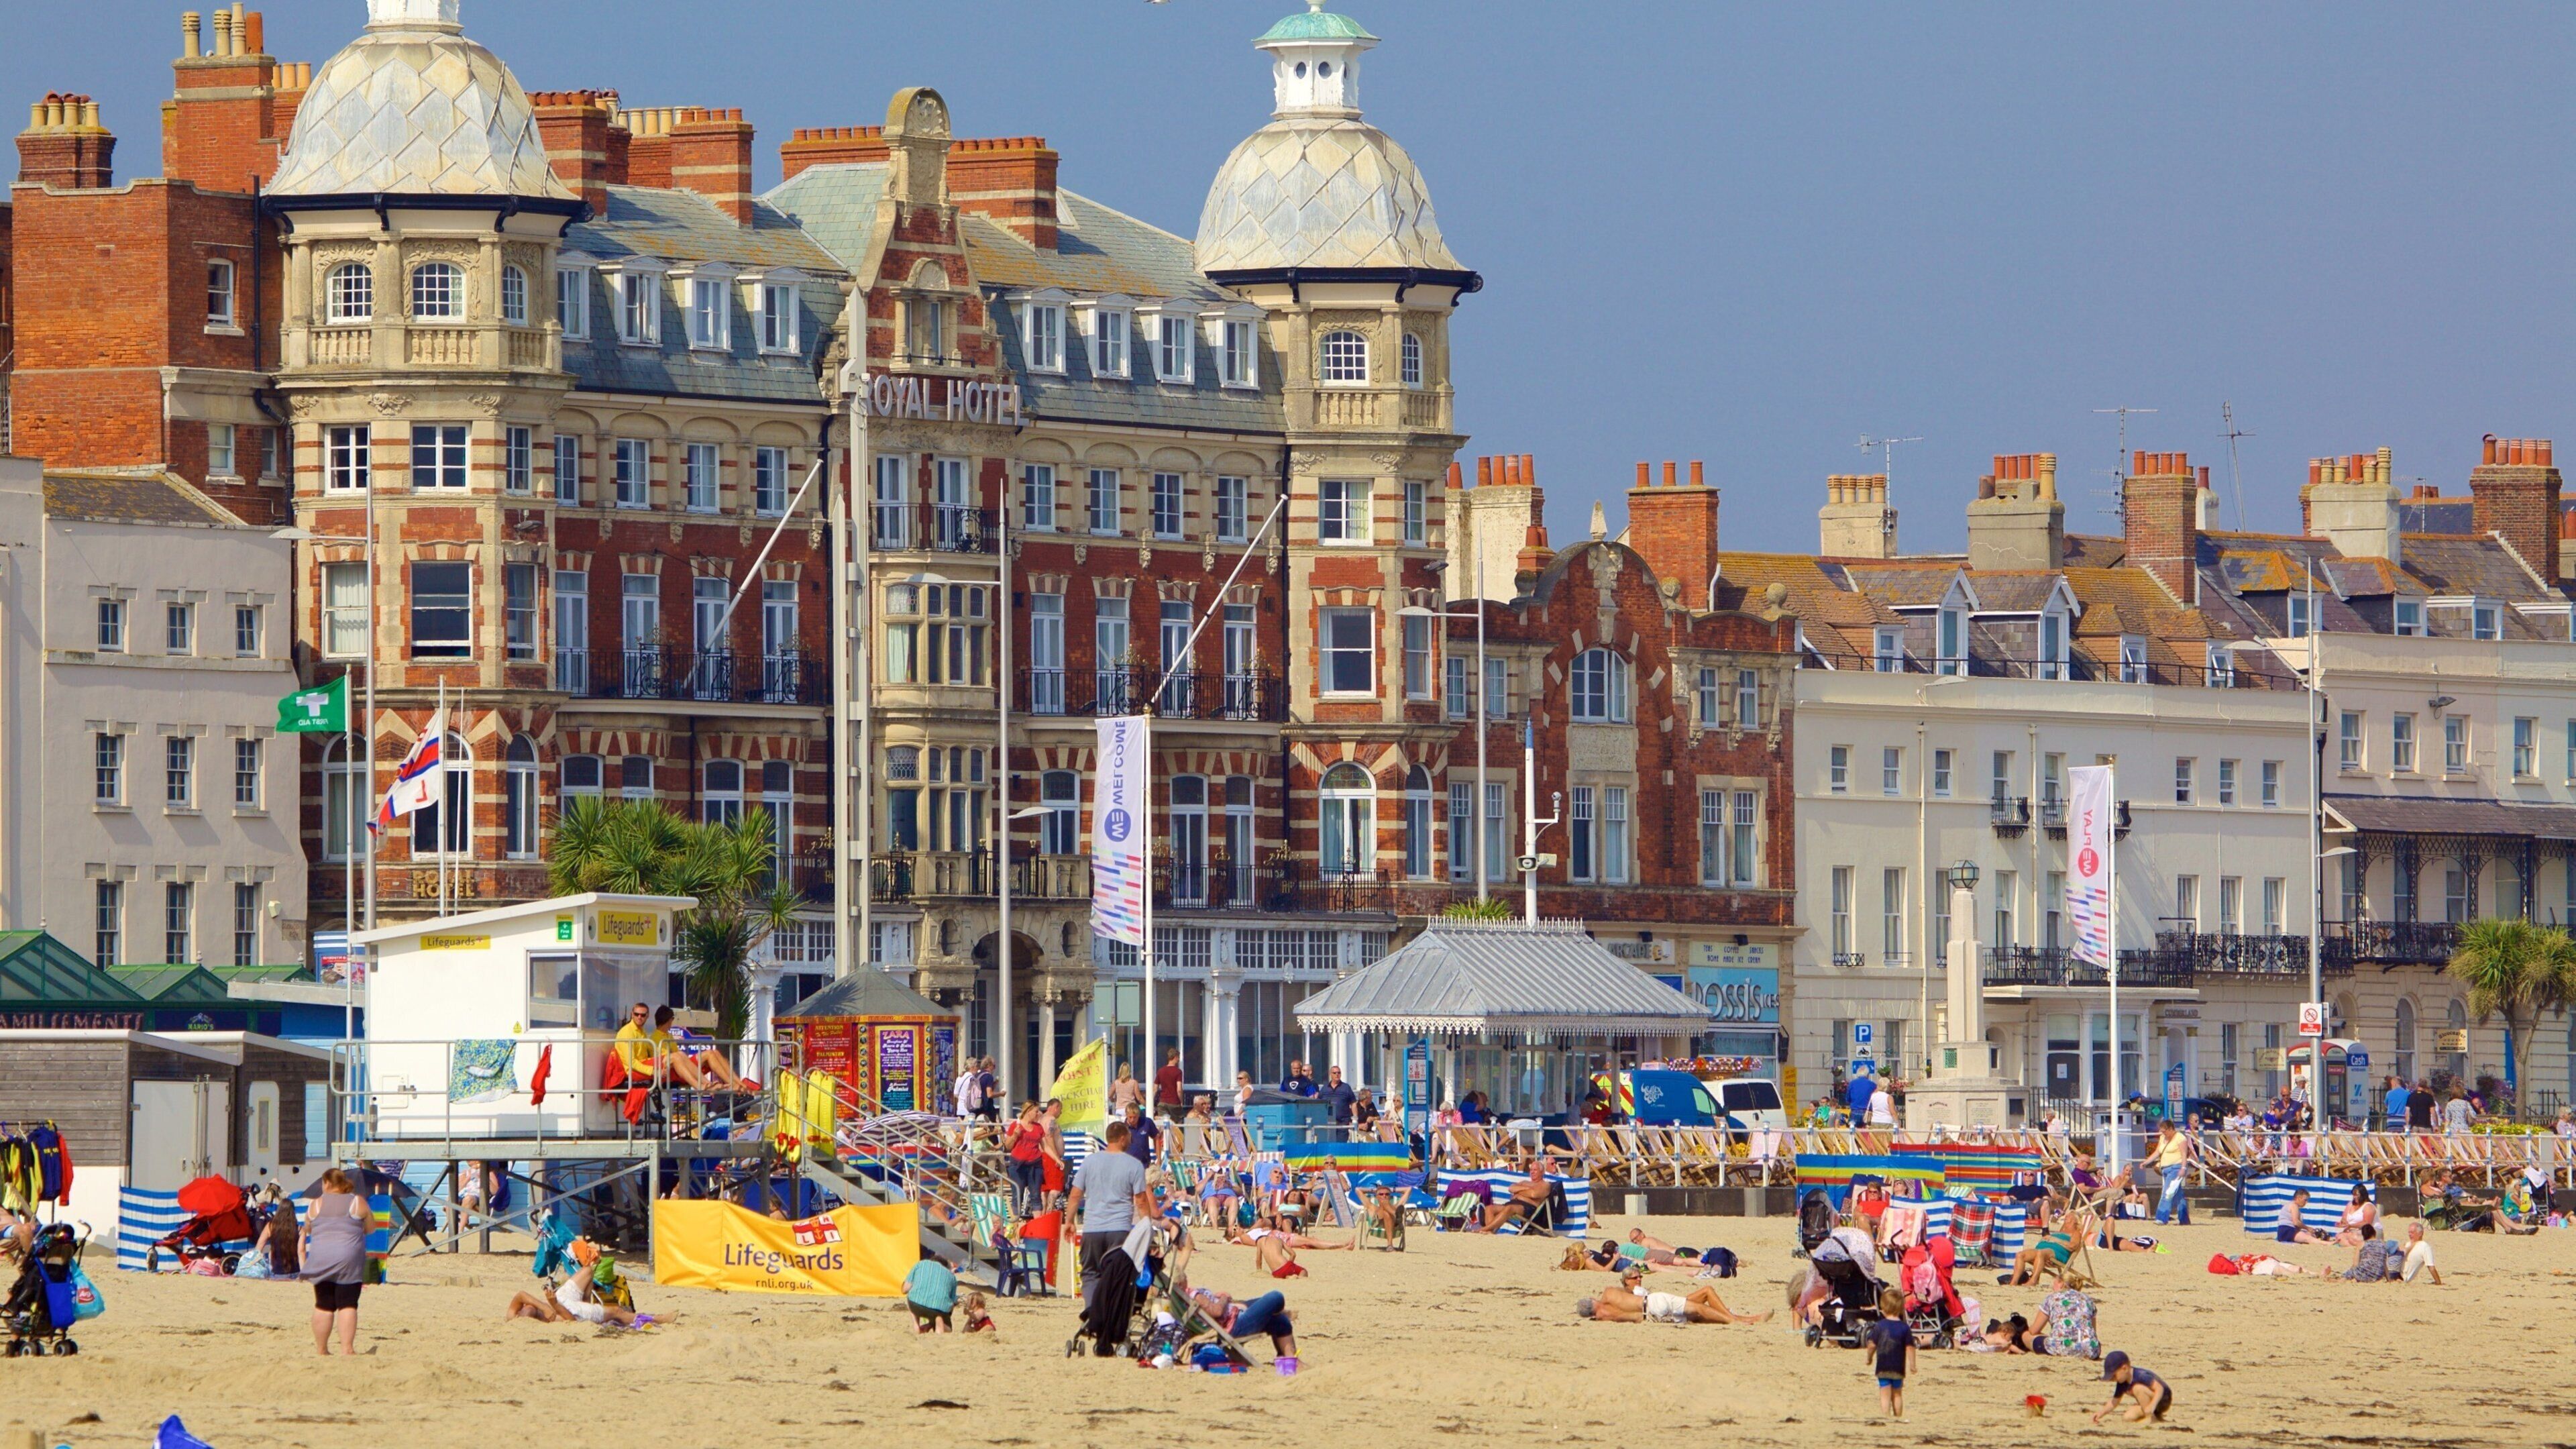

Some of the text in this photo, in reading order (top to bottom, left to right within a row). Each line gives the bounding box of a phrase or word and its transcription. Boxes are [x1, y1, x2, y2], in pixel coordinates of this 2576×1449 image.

[947, 379, 1030, 427] HOTEL
[603, 913, 645, 941] Lifeguards
[427, 936, 476, 949] Lifeguards
[1608, 943, 1652, 958] ARCADE
[1760, 994, 1780, 1008] ICES
[881, 1031, 910, 1040] ZARA
[1859, 1026, 1870, 1041] P
[2351, 1055, 2365, 1065] Cash
[1071, 1100, 1095, 1111] HIRE
[724, 1243, 843, 1274] Lifeguards
[755, 1279, 813, 1291] rnli.org.uk
